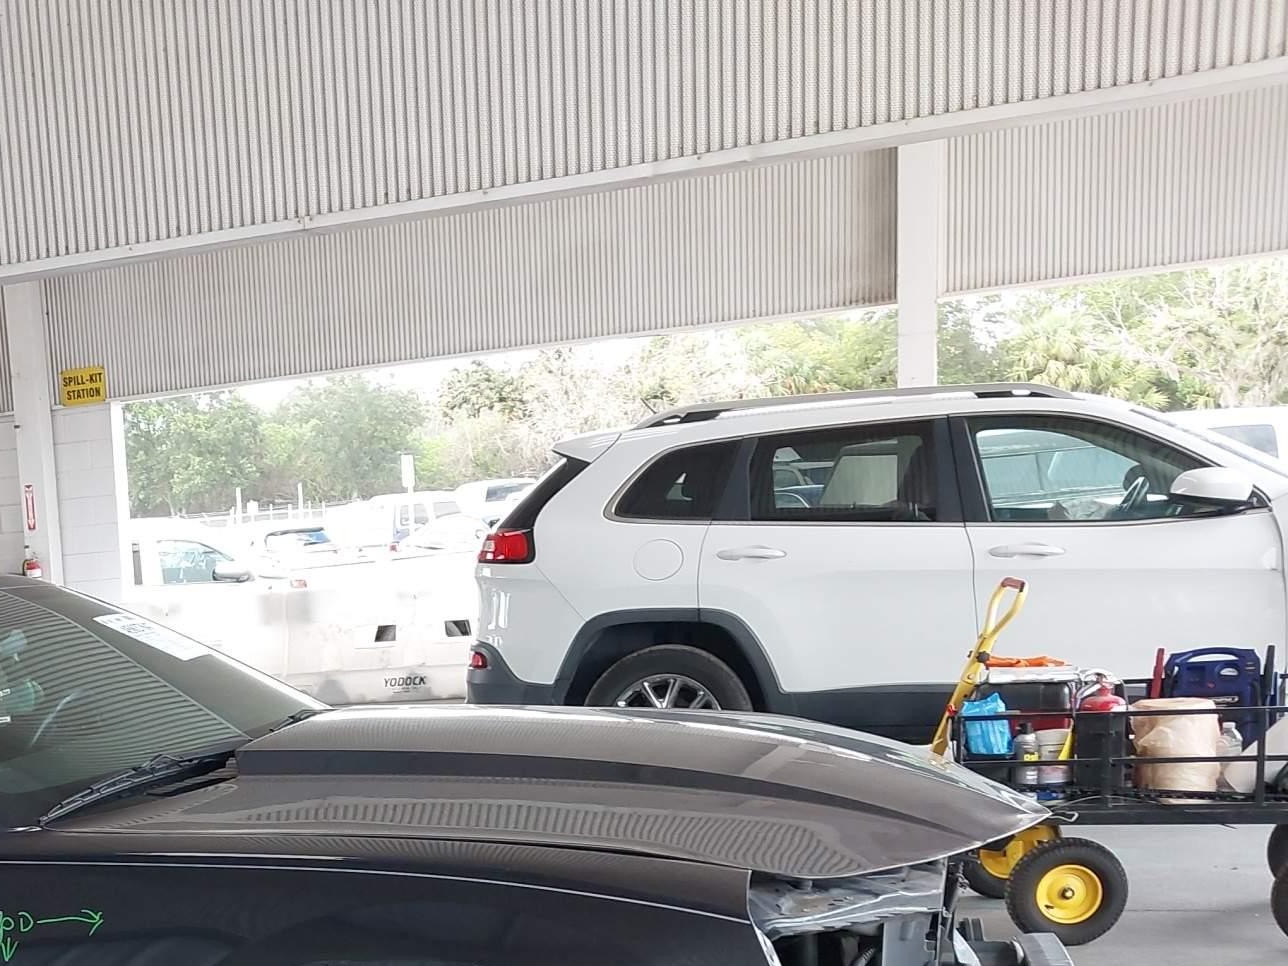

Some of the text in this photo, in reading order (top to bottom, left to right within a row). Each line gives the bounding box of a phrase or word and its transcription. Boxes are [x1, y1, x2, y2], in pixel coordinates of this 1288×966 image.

[63, 372, 102, 387] SPILL-KIT
[66, 387, 101, 401] STATION
[384, 675, 426, 688] YODOCK
